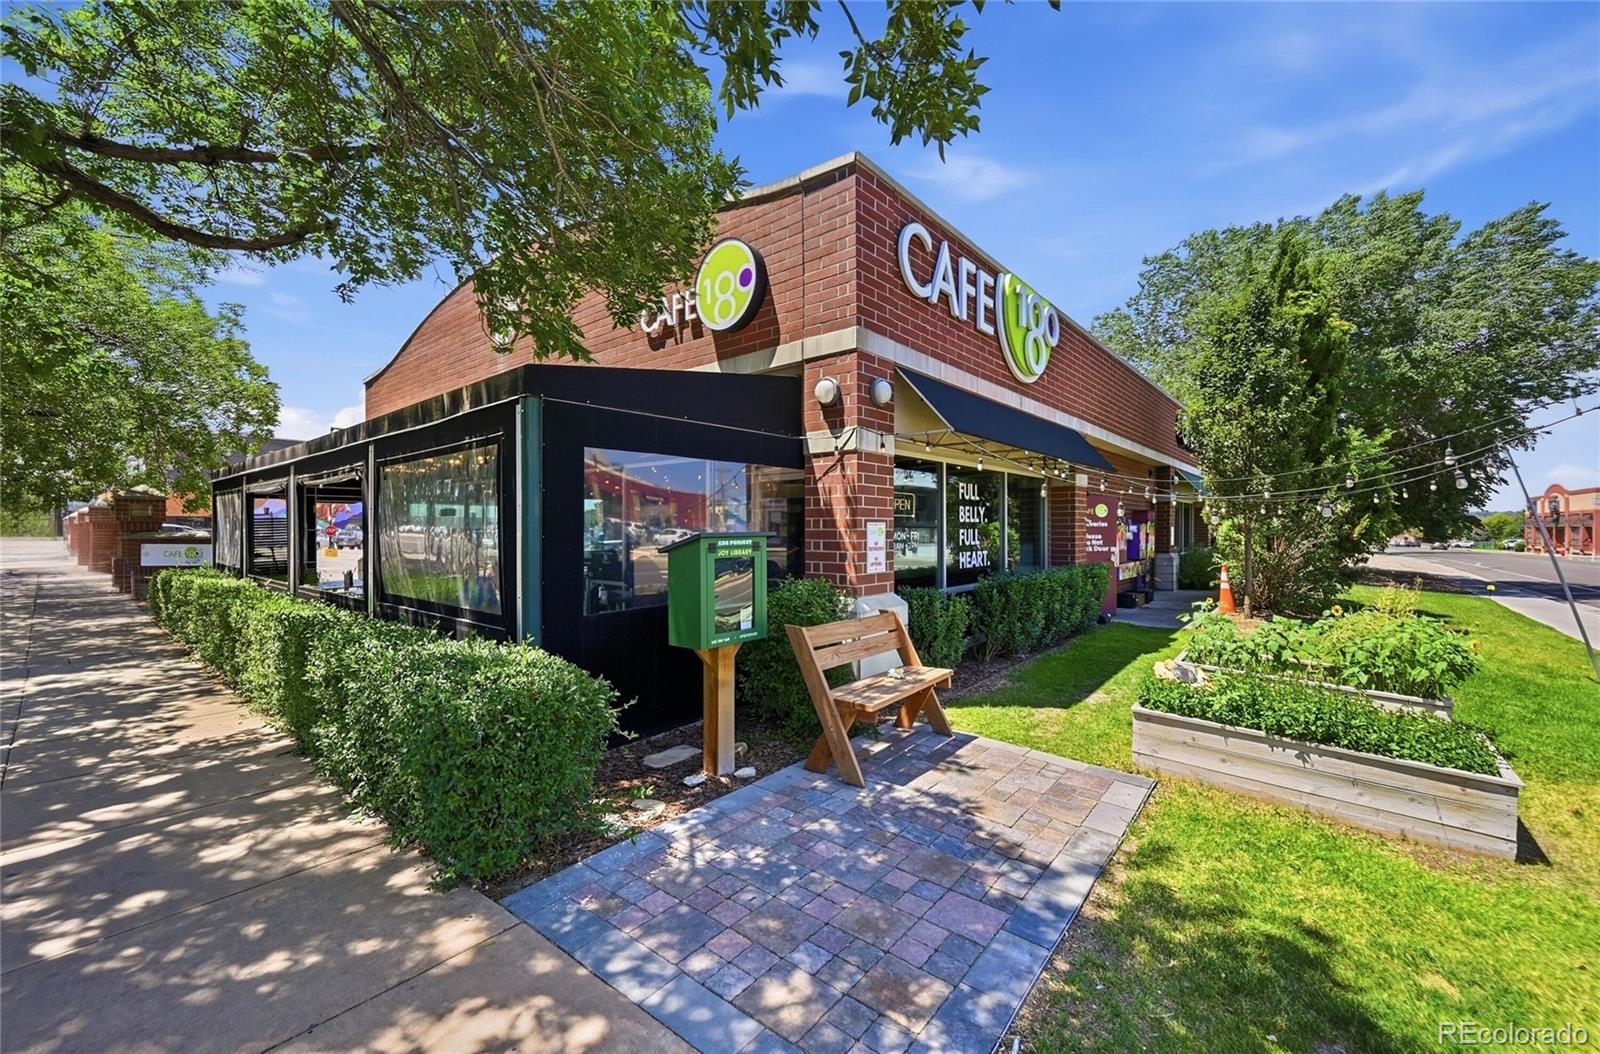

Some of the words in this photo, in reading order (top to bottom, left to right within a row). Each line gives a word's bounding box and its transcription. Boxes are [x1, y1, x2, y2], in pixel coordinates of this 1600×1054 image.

[897, 222, 995, 337] CAFE
[1016, 284, 1060, 376] 180
[640, 288, 699, 333] CAFE
[959, 482, 980, 500] FULL
[894, 498, 910, 510] PEN
[959, 505, 988, 523] BELLY.
[910, 531, 920, 540] FRI
[959, 528, 980, 545] FULL
[163, 550, 183, 558] CAFE
[730, 548, 752, 556] LIBRARY
[959, 551, 990, 569] HEART.
